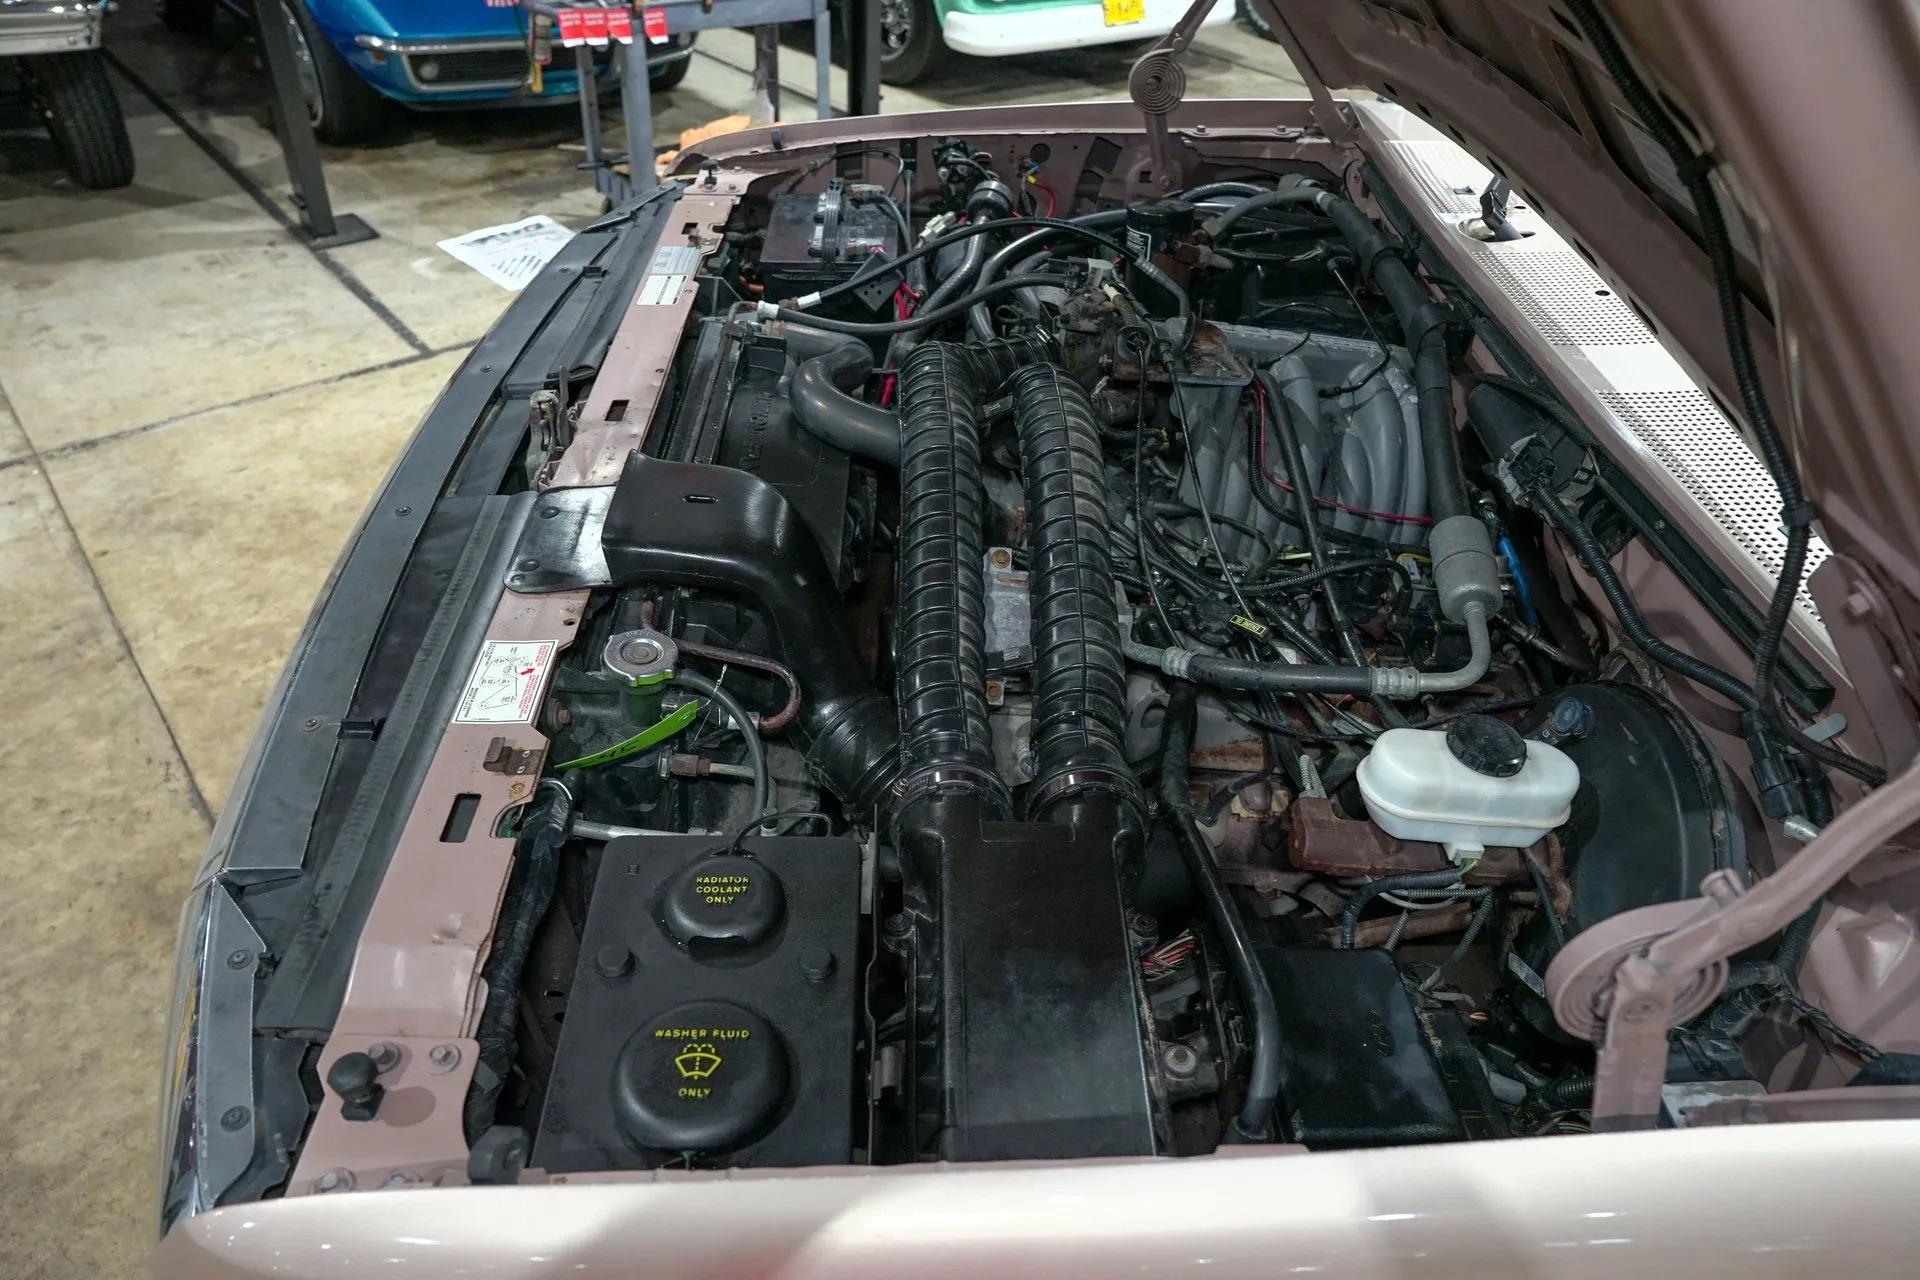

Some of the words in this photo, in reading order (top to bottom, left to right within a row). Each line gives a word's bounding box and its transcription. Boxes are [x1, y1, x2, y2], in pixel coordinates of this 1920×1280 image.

[696, 876, 749, 884] RADIATOR
[705, 896, 734, 904] ONLY
[655, 1029, 707, 1038] WASHER
[712, 1029, 750, 1038] FLUID
[678, 1087, 711, 1098] ONLY
